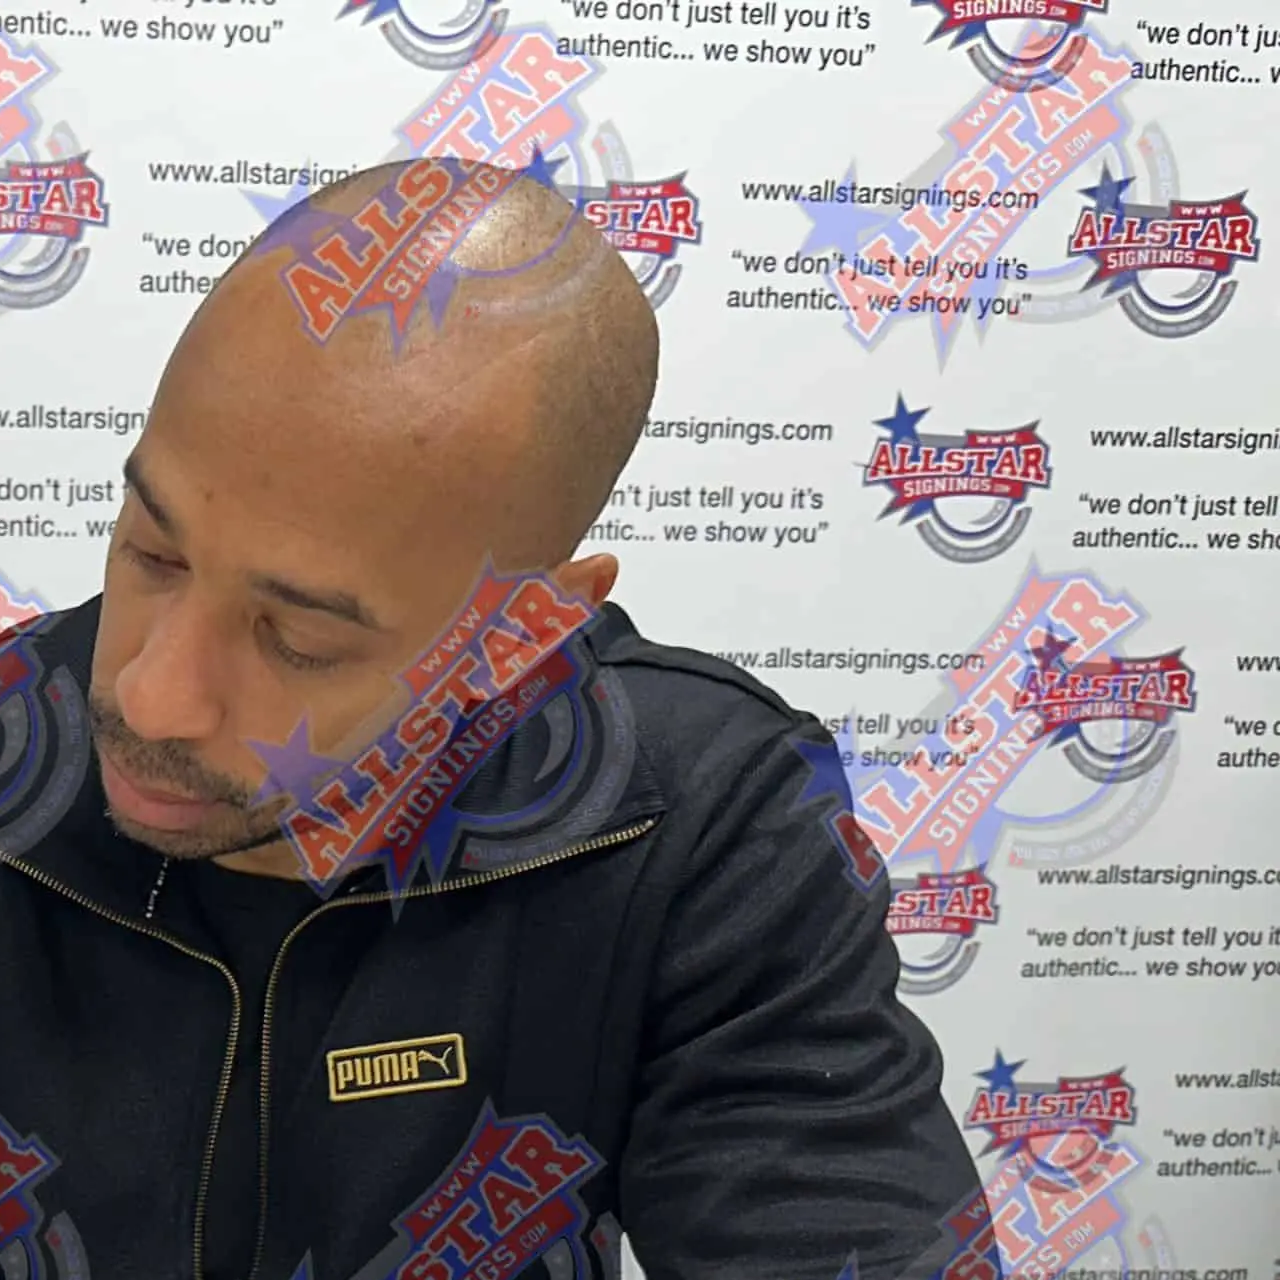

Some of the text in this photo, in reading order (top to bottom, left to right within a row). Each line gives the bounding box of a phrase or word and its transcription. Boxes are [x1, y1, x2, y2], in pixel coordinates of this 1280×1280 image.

[100, 20, 138, 38] we
[146, 16, 215, 41] show
[685, 0, 732, 28] just
[741, 2, 776, 25] tell
[784, 9, 829, 32] you
[557, 33, 694, 60] authentic...
[704, 43, 738, 62] we
[746, 40, 812, 64] show
[742, 180, 1040, 213] www.allstarsignings.com
[1072, 211, 1255, 257] ALLSTAR
[851, 253, 897, 281] just
[904, 255, 939, 277] tell
[945, 261, 988, 284] you
[1107, 250, 1195, 269] SIGNINGS
[726, 286, 858, 311] authentic...
[868, 294, 901, 312] we
[908, 291, 972, 314] show
[867, 441, 1047, 485] ALLSTAR
[903, 477, 991, 497] SIGNINGS
[1192, 494, 1237, 521] just
[1131, 927, 1175, 950] just
[1182, 927, 1217, 946] tell
[1222, 931, 1263, 951] you
[336, 1050, 420, 1091] PUMA
[968, 1087, 1132, 1123] ALLSTAR
